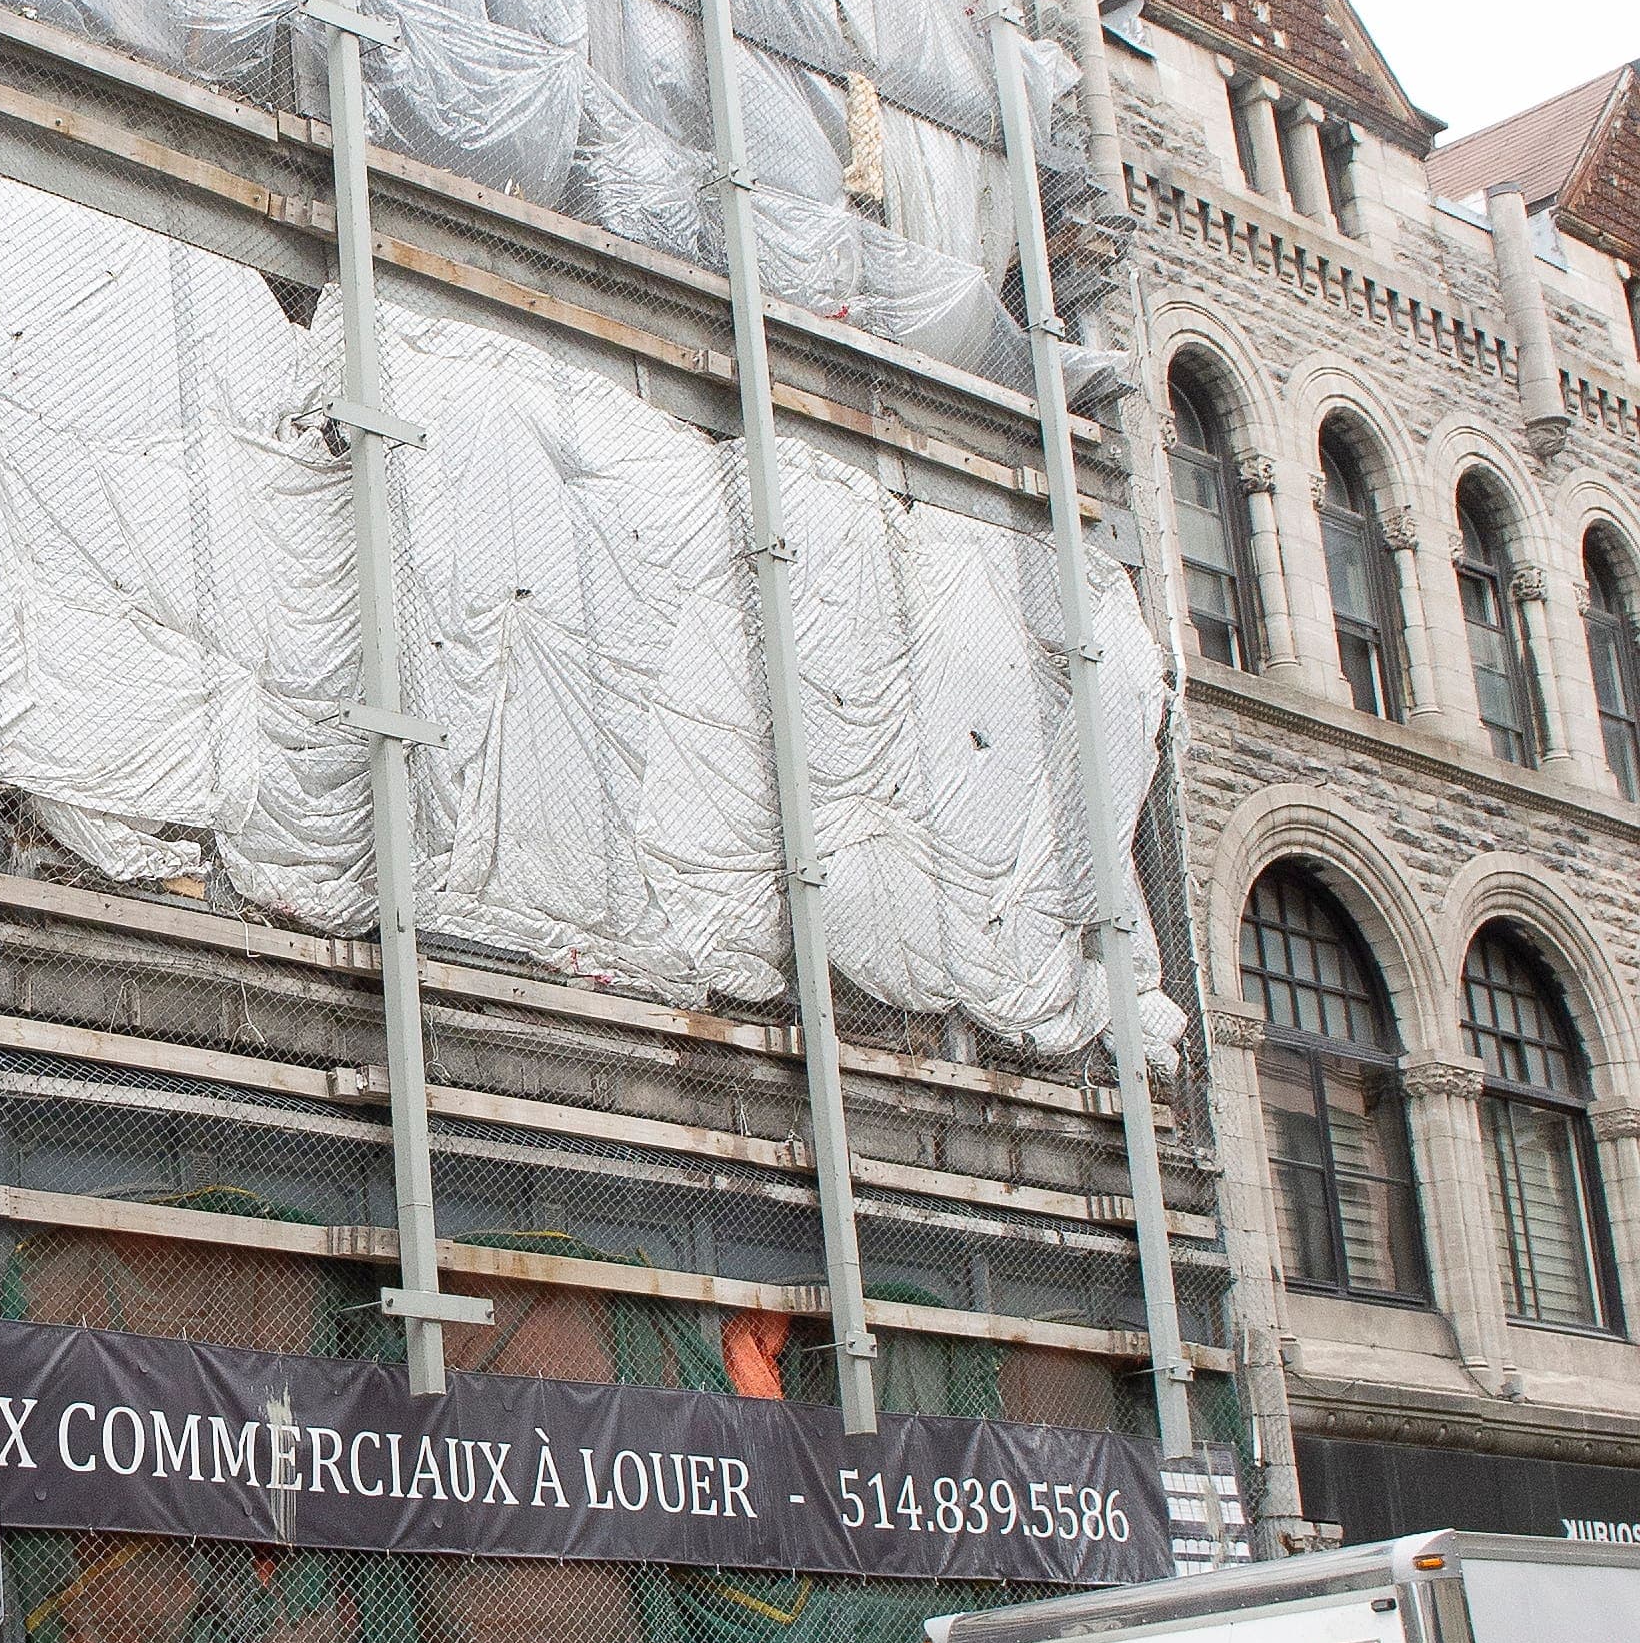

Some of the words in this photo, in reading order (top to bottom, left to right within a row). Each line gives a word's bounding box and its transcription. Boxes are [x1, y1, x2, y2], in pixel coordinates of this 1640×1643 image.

[58, 1401, 519, 1506] COMMERCIAUX
[531, 1426, 570, 1508] À
[578, 1446, 758, 1520] LOUER
[840, 1468, 1131, 1544] 514.839.5586
